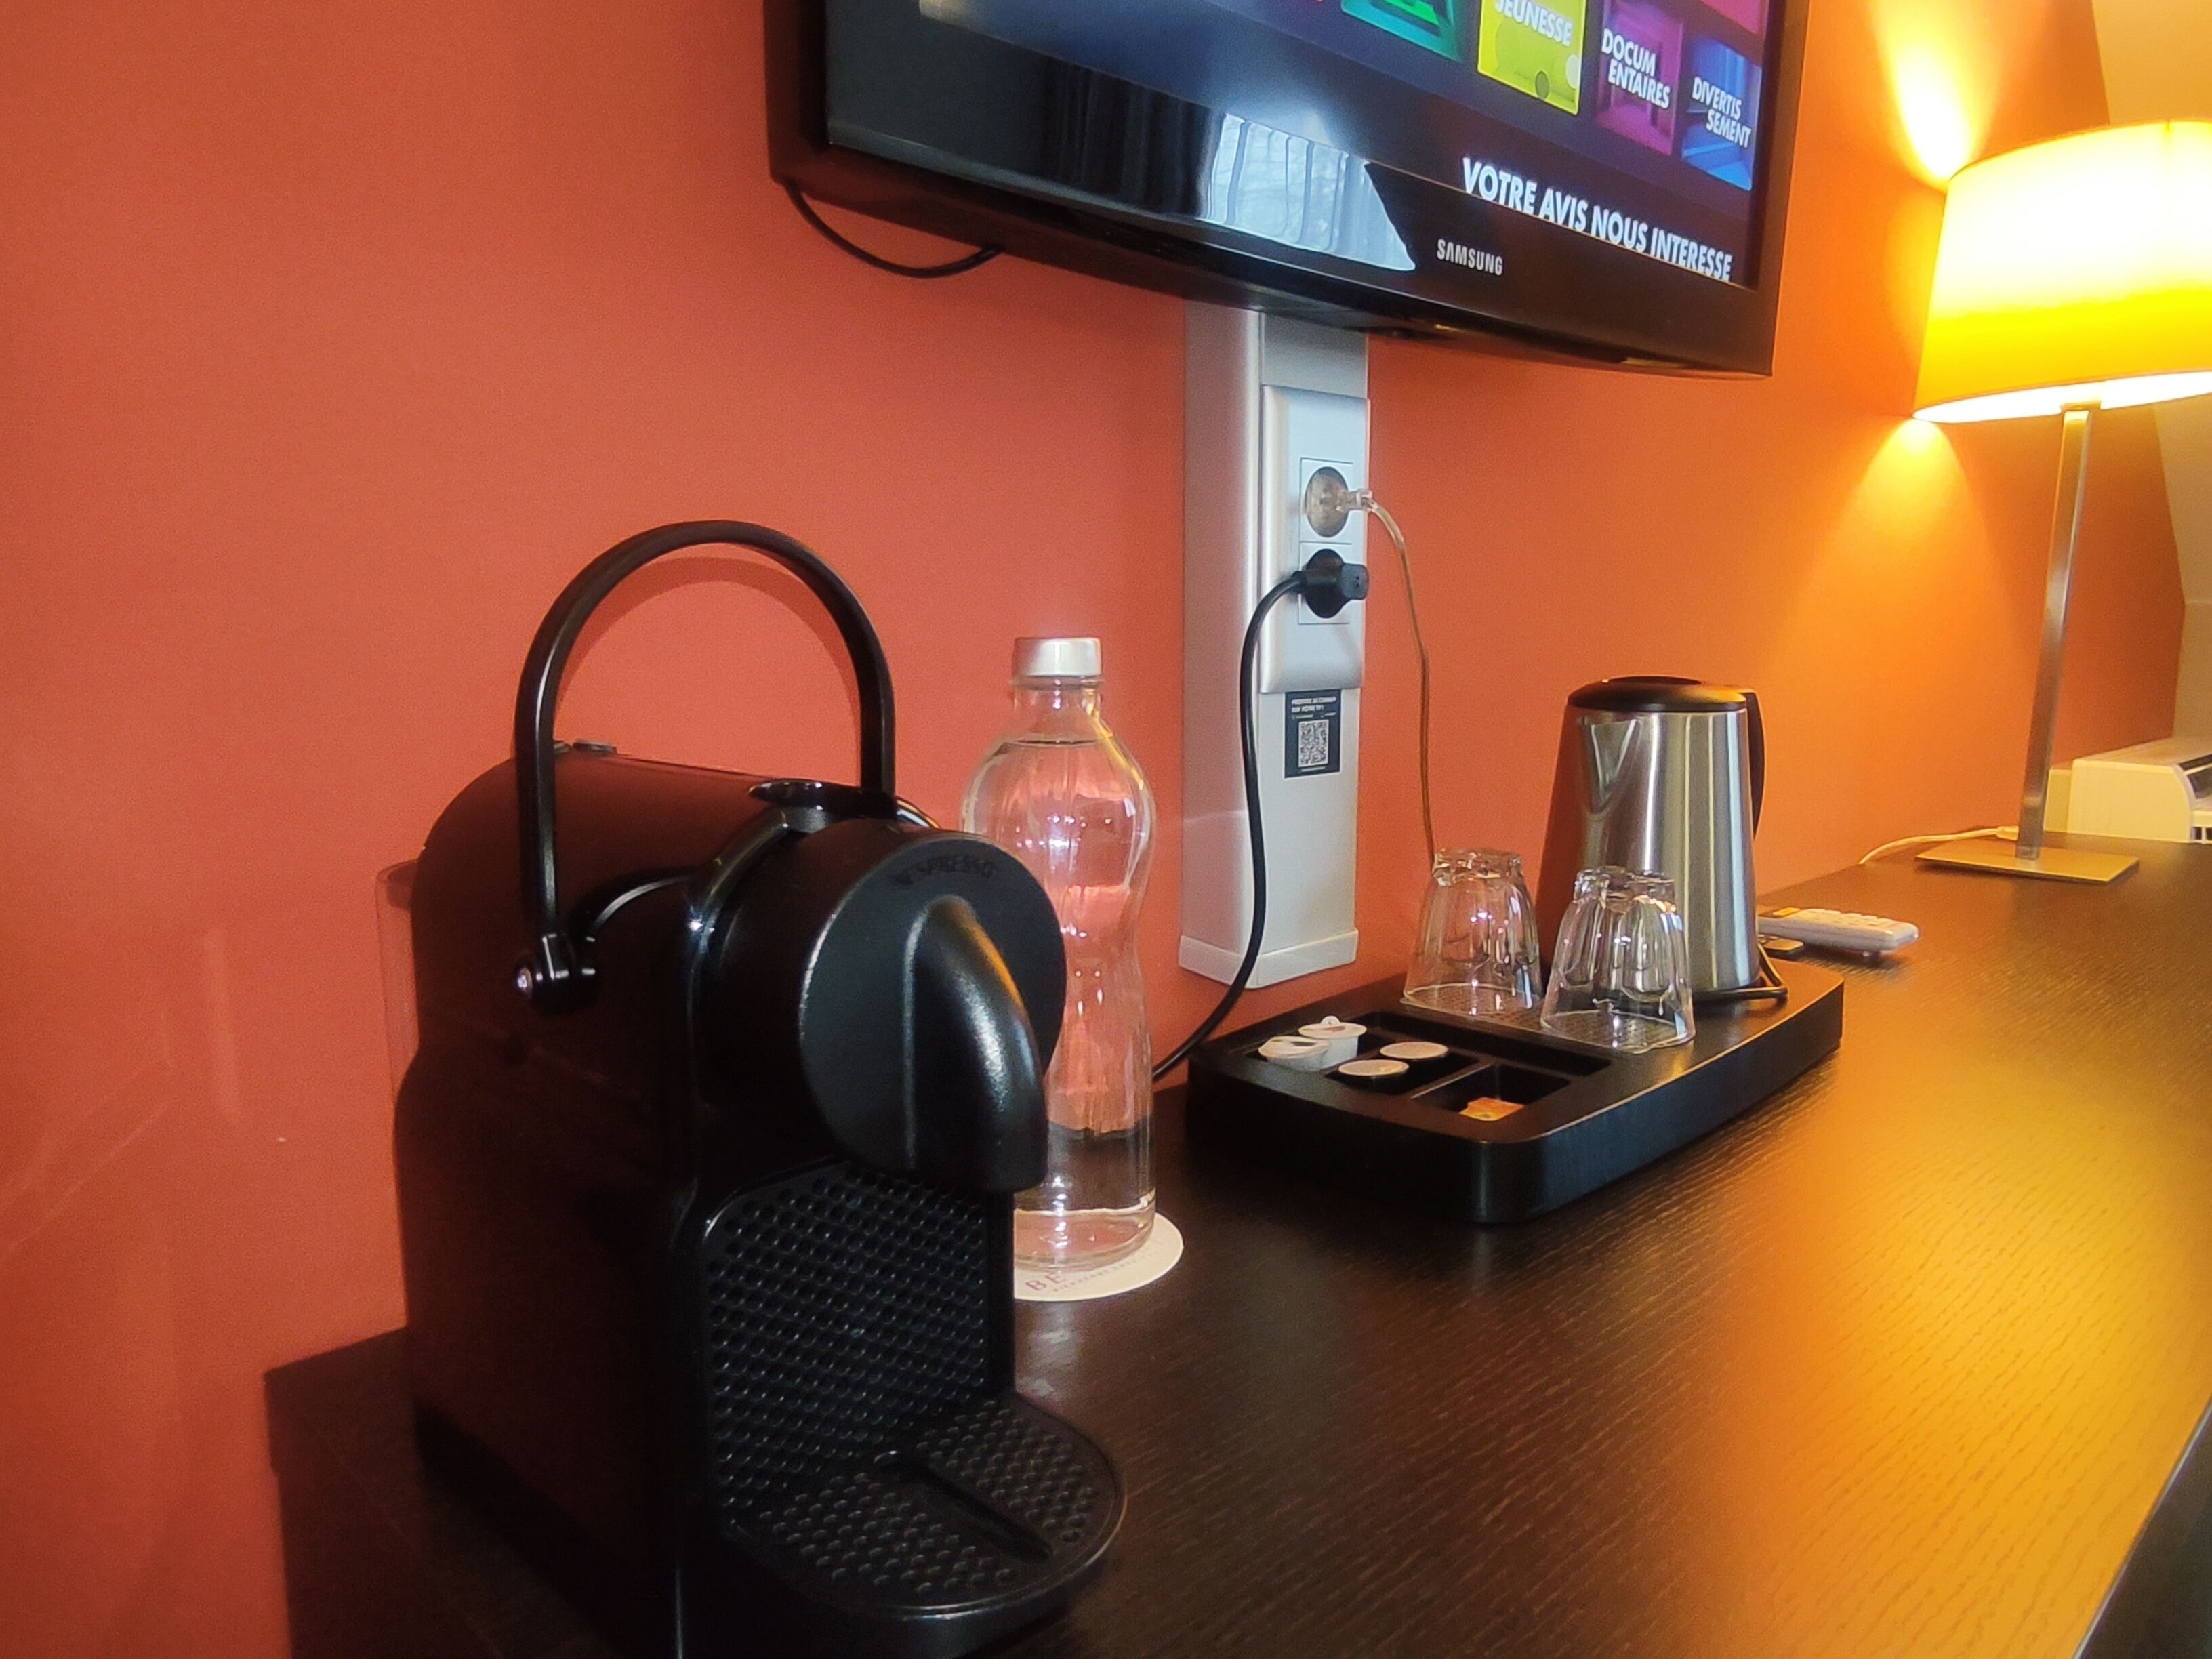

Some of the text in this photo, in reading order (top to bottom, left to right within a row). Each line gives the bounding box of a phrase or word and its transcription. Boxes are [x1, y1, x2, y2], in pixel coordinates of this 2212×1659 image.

[1495, 0, 1573, 47] JEUNESSE
[1601, 28, 1656, 77] DOCUM
[1607, 58, 1671, 109] ENTAIRES
[1692, 76, 1742, 121] DIVERTIS
[1706, 108, 1751, 148] SEMENT
[1462, 157, 1732, 281] VOTRE AVIS NOUS INTERESSE
[1437, 238, 1503, 276] SAMSUNG
